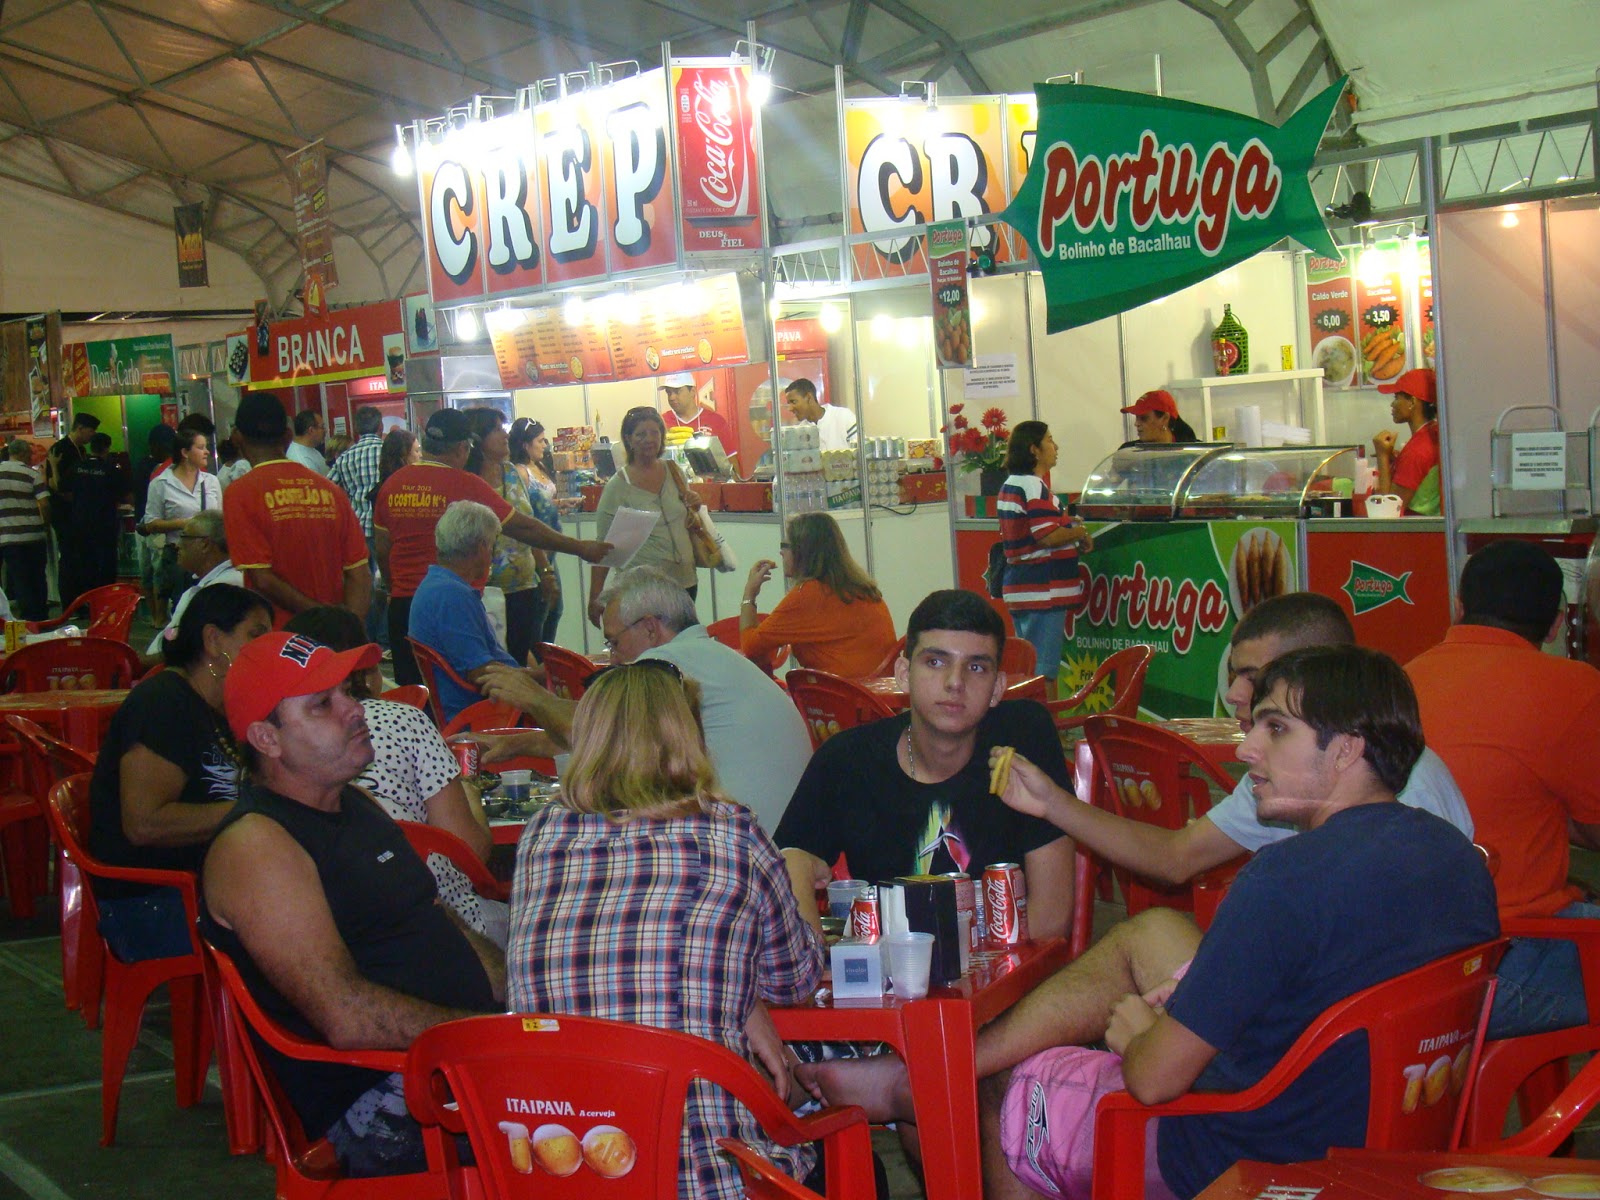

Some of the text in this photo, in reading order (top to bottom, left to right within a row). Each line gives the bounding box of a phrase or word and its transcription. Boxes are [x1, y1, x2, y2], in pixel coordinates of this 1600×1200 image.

[693, 72, 739, 209] Coca-Cola
[858, 130, 1037, 263] CR
[699, 230, 724, 239] DEUS
[720, 238, 745, 248] FIEL
[1058, 233, 1192, 261] Bolinho de Bacalhau
[943, 289, 960, 304] 12,00
[1312, 290, 1349, 301] Caldo Verde
[1323, 314, 1341, 328] 6,00
[1372, 309, 1390, 325] 3,50
[777, 332, 801, 342] PAVA
[278, 324, 365, 373] BRANCA
[91, 364, 111, 389] Don
[117, 358, 140, 387] Carlo
[369, 381, 388, 391] ITAI
[264, 491, 275, 509] O
[388, 493, 393, 508] O
[394, 491, 431, 507] COSTELÃO
[1076, 636, 1111, 649] BOLINHO
[1112, 638, 1123, 651] DE
[986, 876, 1007, 940] Coca-Cola
[1418, 1029, 1460, 1055] ITAIPAVA
[506, 1097, 616, 1118] ITAIPAVA A cerveja
[497, 1120, 638, 1179] 100
